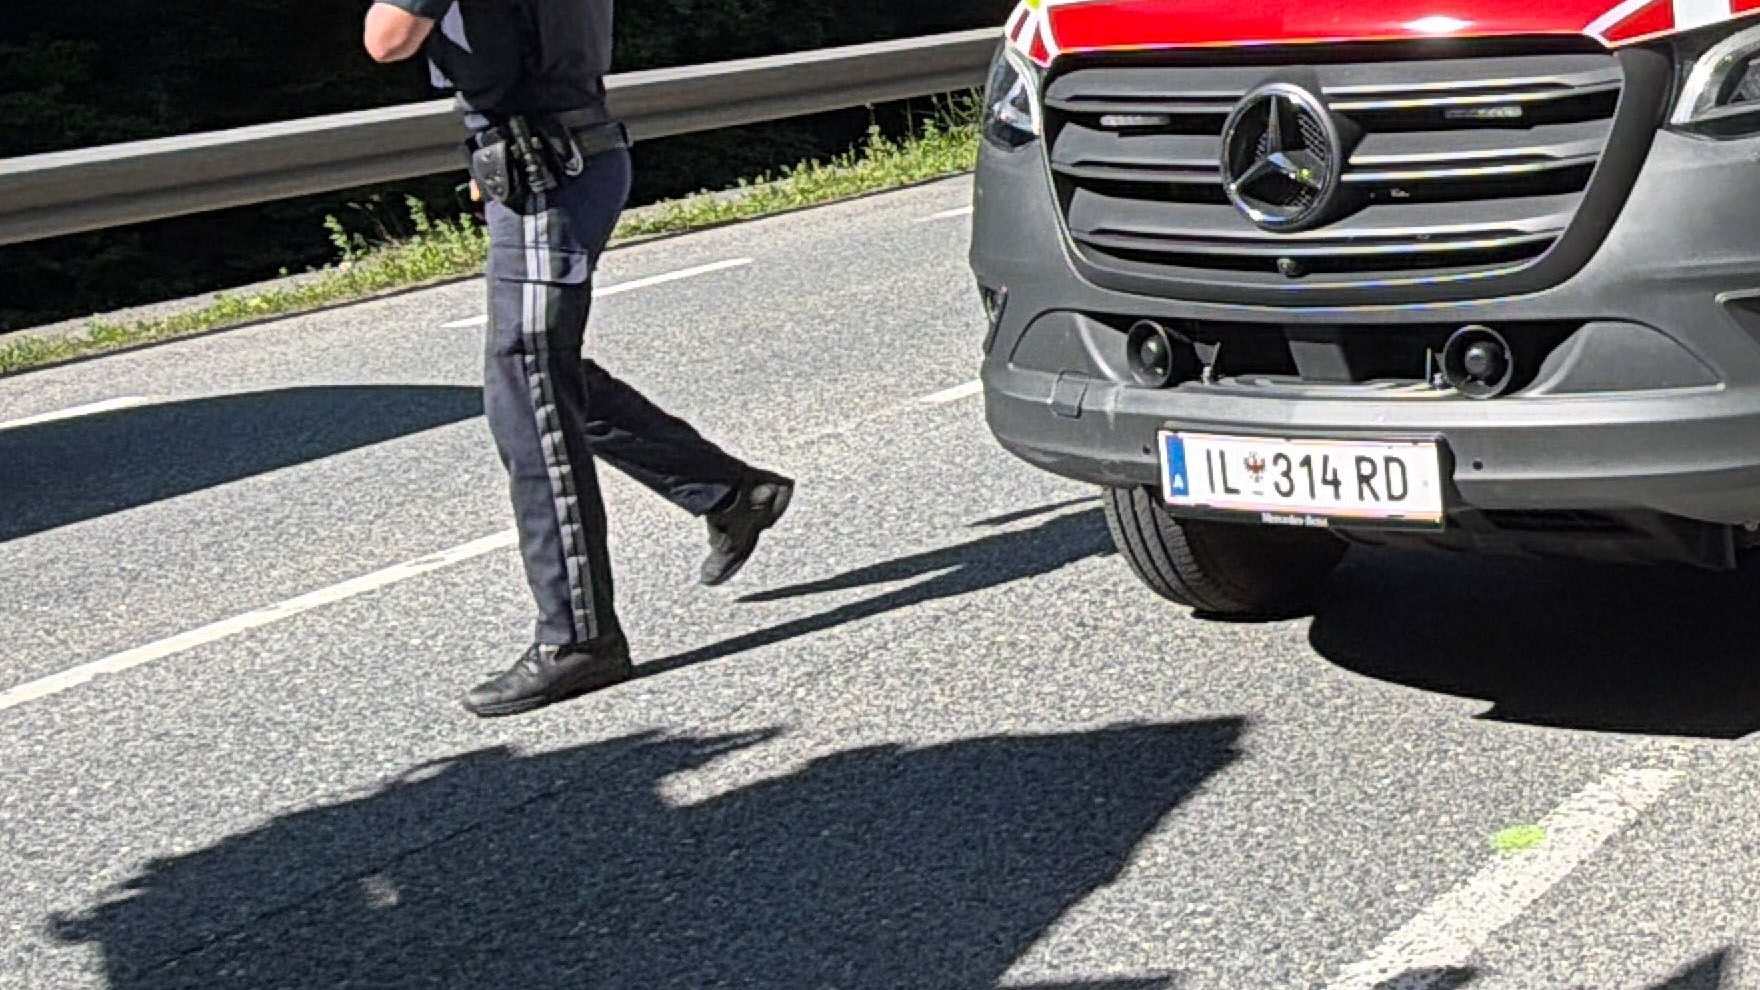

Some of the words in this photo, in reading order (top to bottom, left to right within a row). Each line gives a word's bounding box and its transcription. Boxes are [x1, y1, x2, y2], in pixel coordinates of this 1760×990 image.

[1206, 448, 1241, 495] IL
[1271, 452, 1342, 500] 314
[1354, 455, 1408, 502] RD
